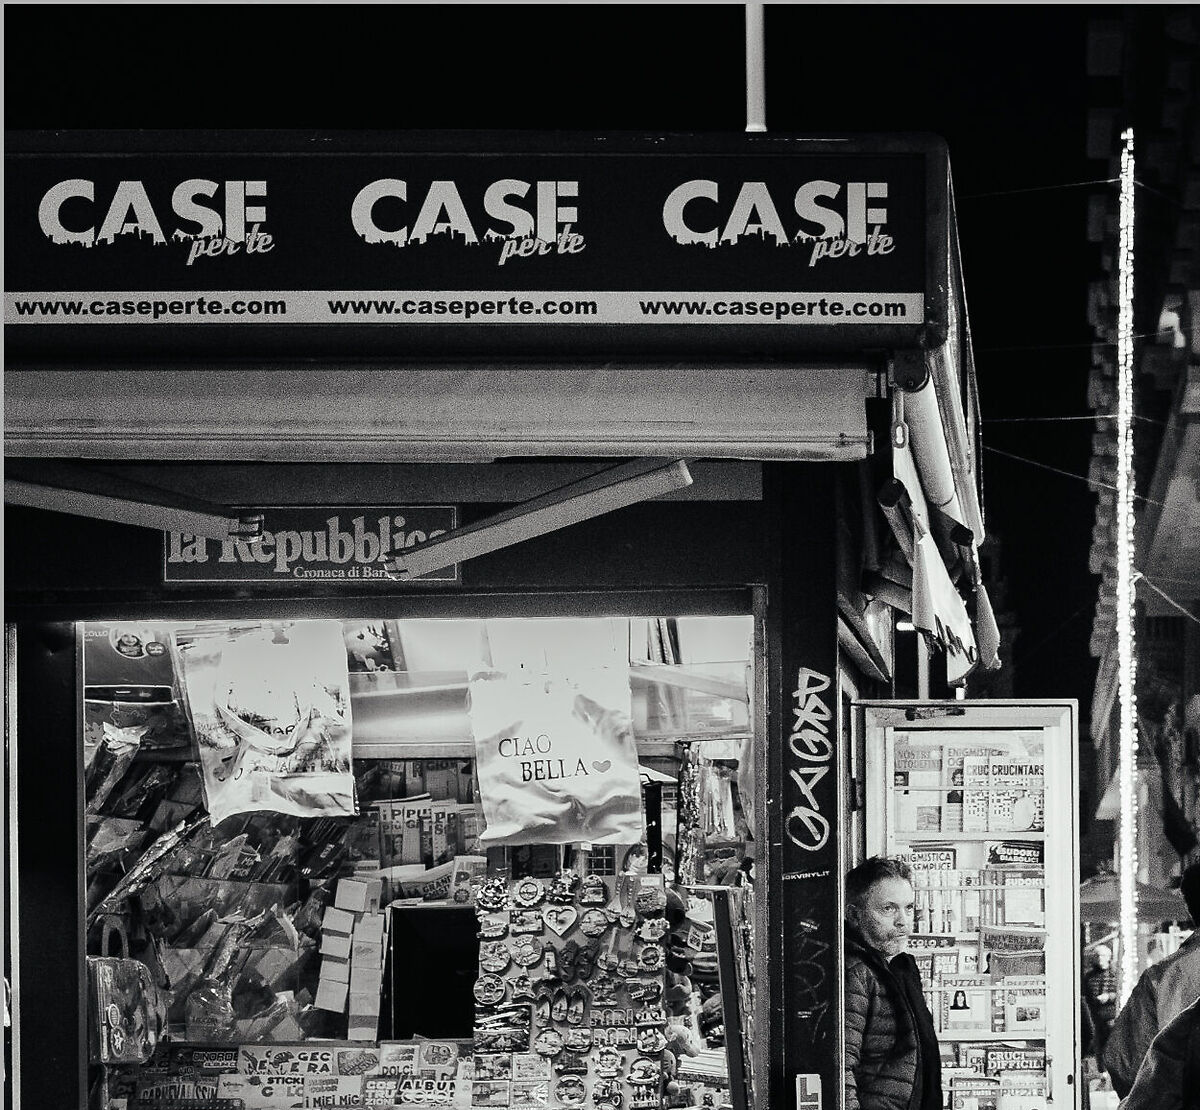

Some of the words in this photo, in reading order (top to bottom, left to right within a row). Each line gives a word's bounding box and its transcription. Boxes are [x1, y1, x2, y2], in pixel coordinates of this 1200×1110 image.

[38, 179, 267, 248] CASE
[351, 178, 579, 248] CASE
[662, 179, 888, 249] CASE
[186, 236, 240, 265] per
[246, 223, 275, 253] te
[498, 237, 552, 266] per
[557, 223, 586, 254] te
[808, 238, 862, 267] per
[867, 225, 896, 255] te
[15, 297, 287, 319] www.caseperte.com
[328, 297, 598, 319] www.caseperte.com
[639, 298, 907, 320] www.caseperte.com
[218, 516, 448, 573] Repubblic
[293, 567, 346, 578] Cronaca
[349, 566, 360, 578] di
[498, 734, 552, 757] CIAO
[520, 757, 589, 782] BELLA
